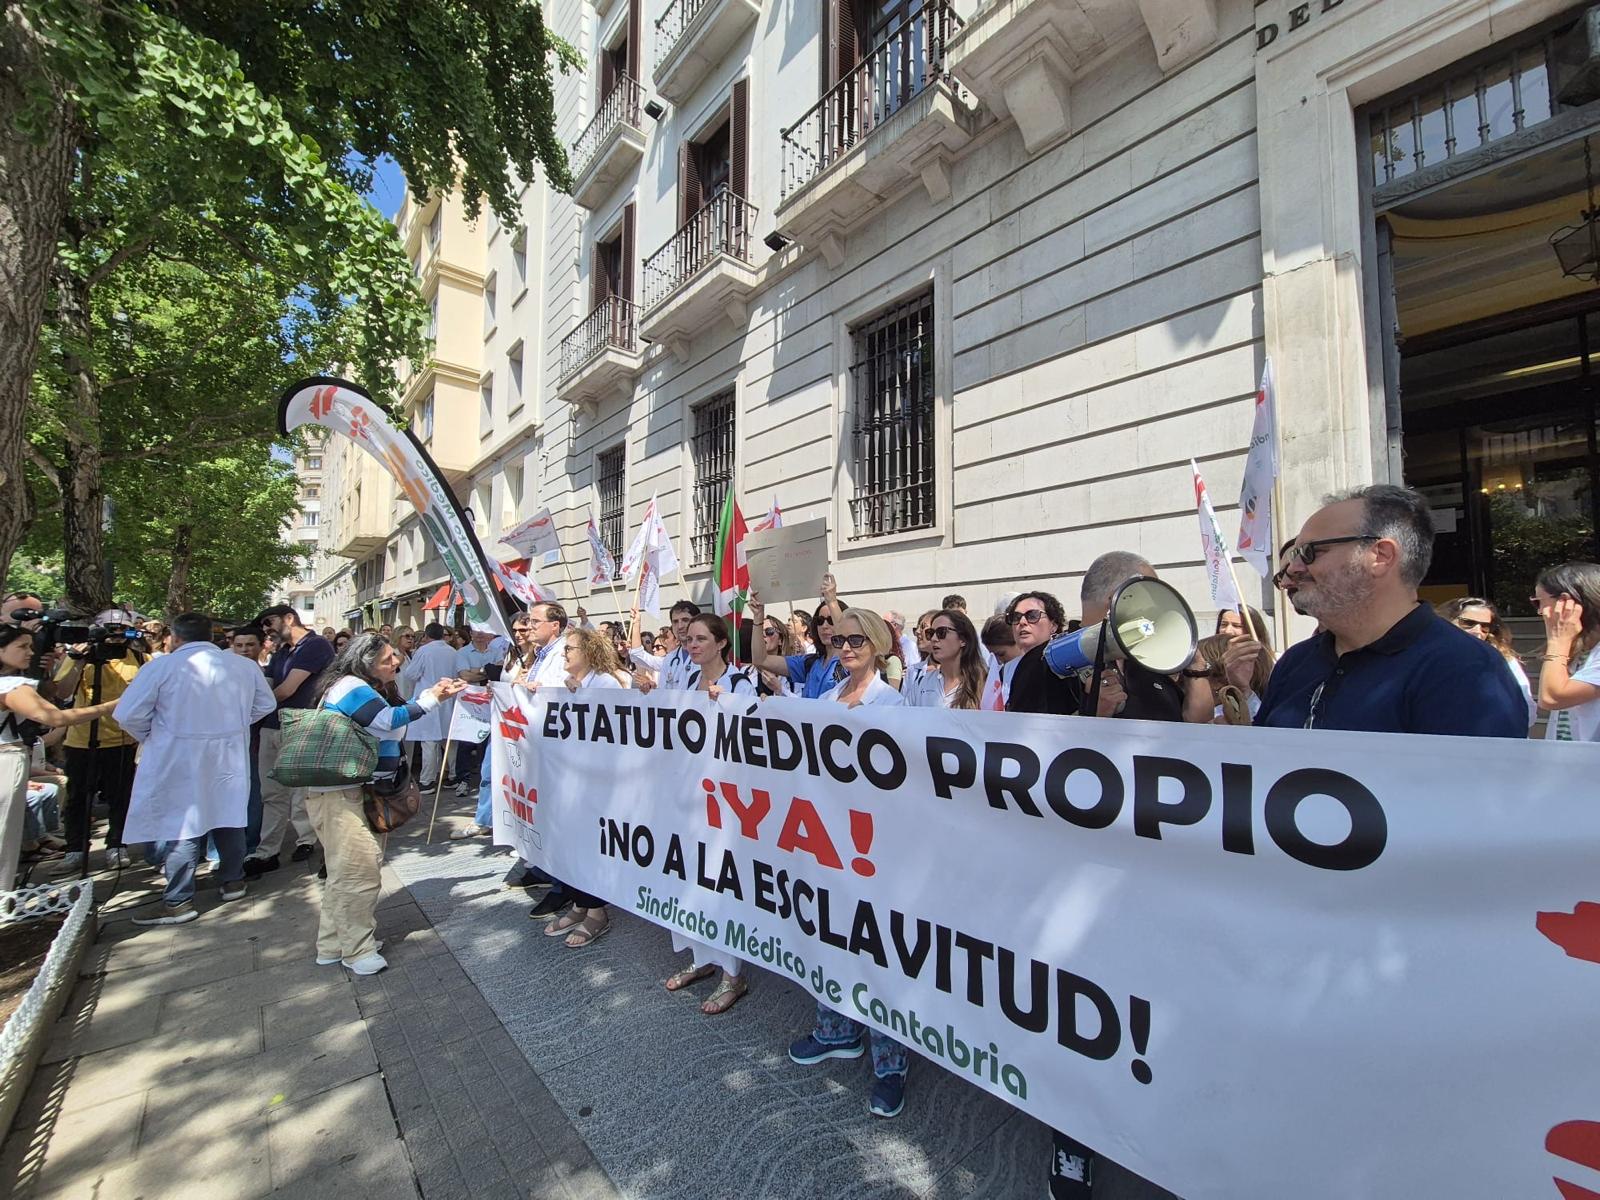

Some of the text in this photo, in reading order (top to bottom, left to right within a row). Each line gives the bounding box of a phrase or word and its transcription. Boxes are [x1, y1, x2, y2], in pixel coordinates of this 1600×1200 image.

[543, 702, 1388, 871] ESTATUTO MÉDICO PROPIO
[702, 778, 876, 877] ¡YA!
[600, 817, 1153, 1086] ¡NO A LA ESCLAVITUD!
[636, 886, 1028, 1100] Sindicato Médico de Cantabria
